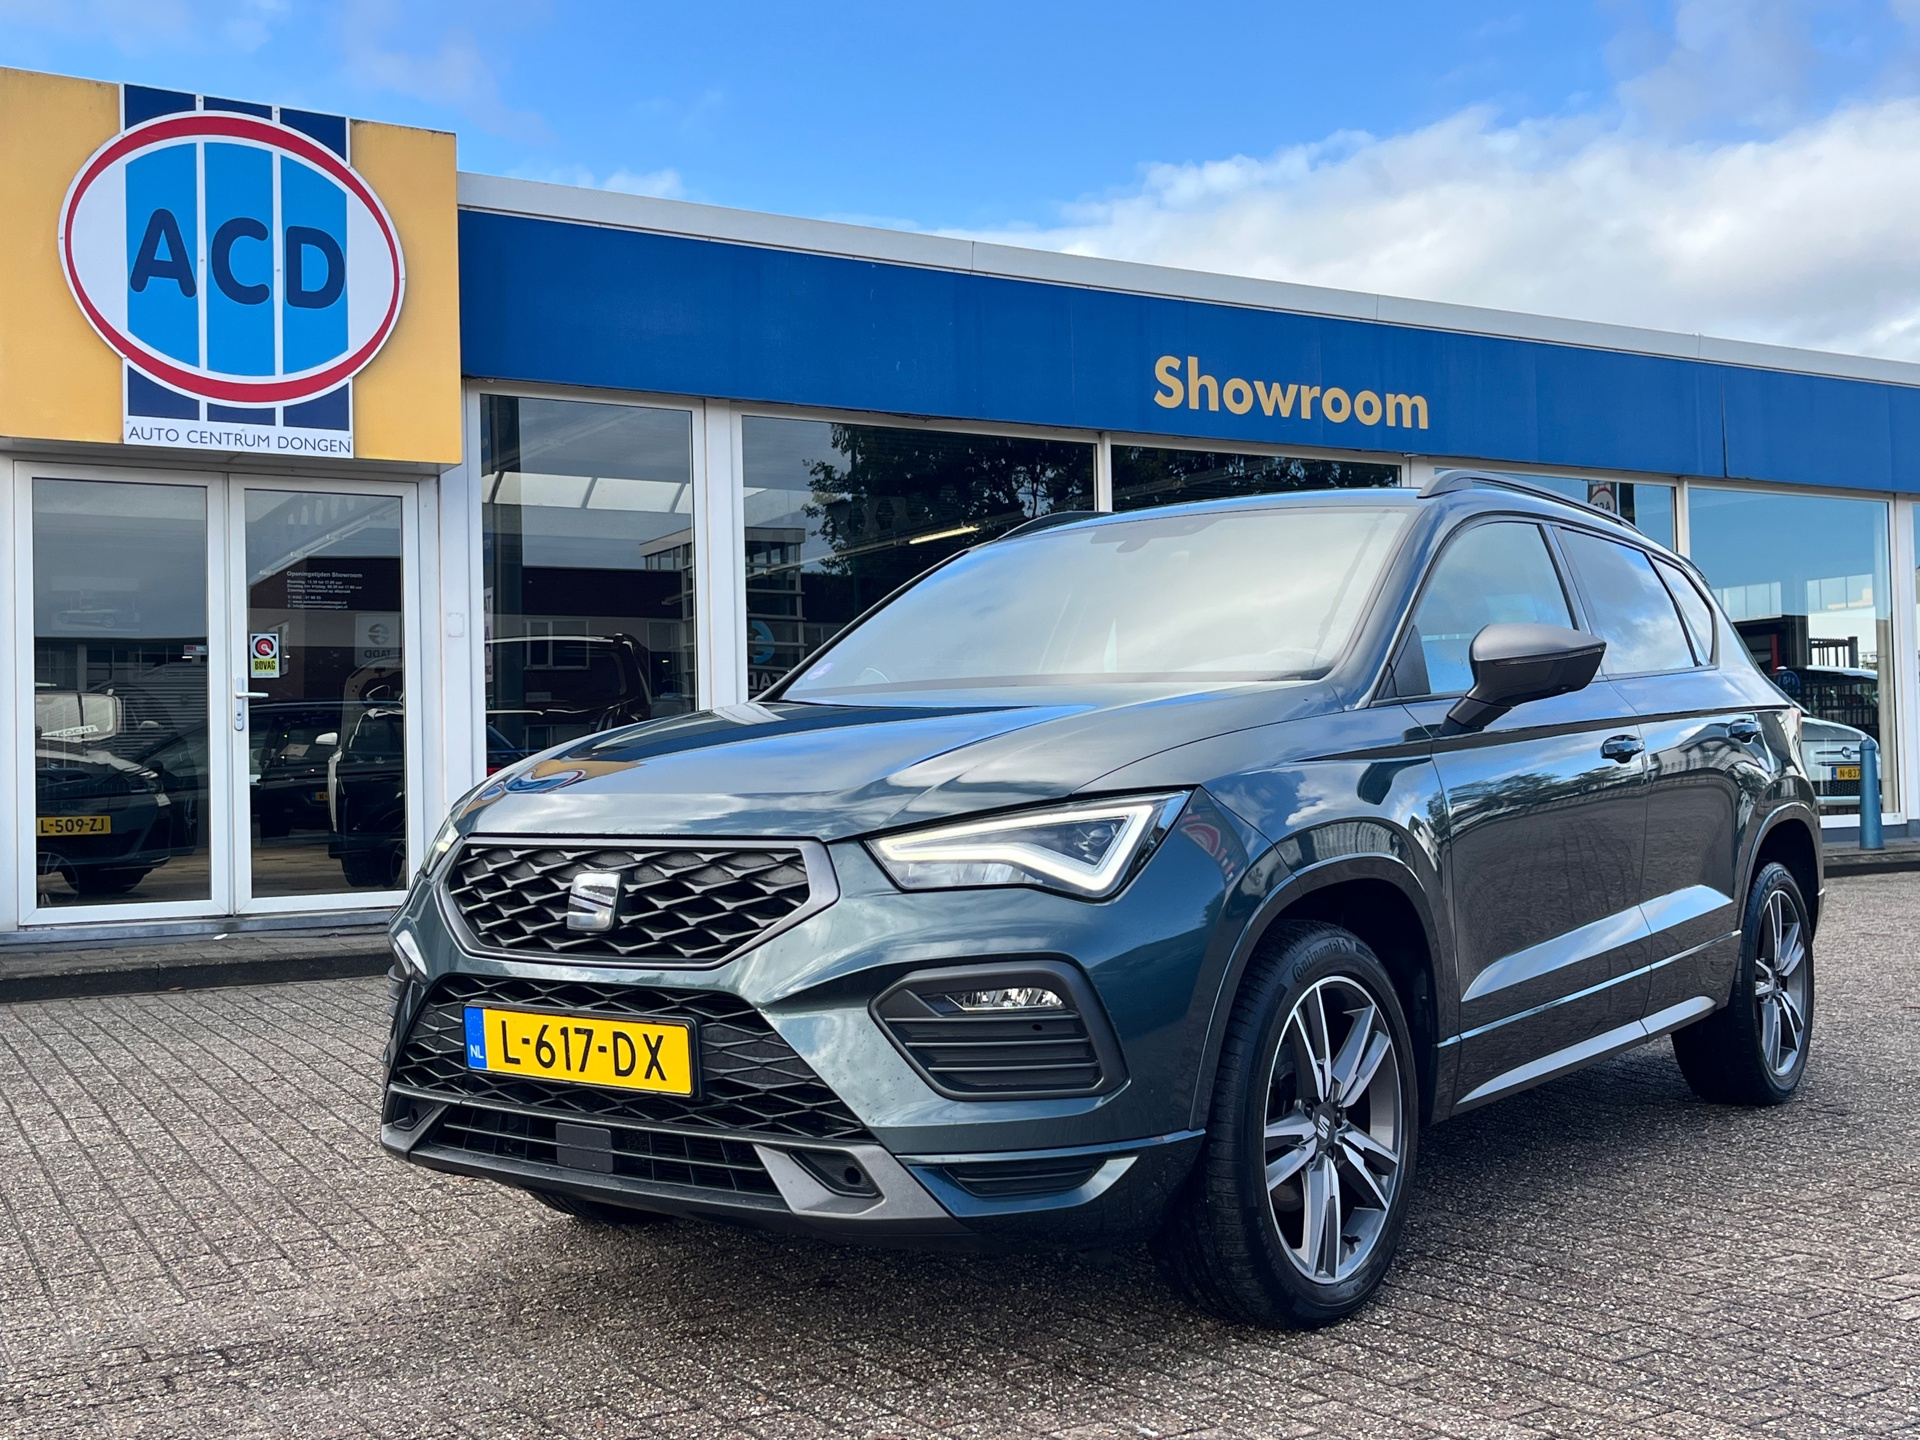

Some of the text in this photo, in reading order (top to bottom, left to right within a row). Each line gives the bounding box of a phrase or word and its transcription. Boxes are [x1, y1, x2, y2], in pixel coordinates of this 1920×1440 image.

[130, 208, 346, 309] ACD
[1154, 355, 1429, 429] Showroom
[128, 426, 351, 453] AUTO CENTRUM DONGEN
[286, 570, 331, 578] Openingstijden
[254, 660, 276, 671] BOVAG
[1839, 768, 1860, 778] N-837
[40, 818, 105, 834] L-509-ZJ
[1291, 938, 1342, 984] Continental
[470, 1019, 668, 1082] NL L-617-DX
